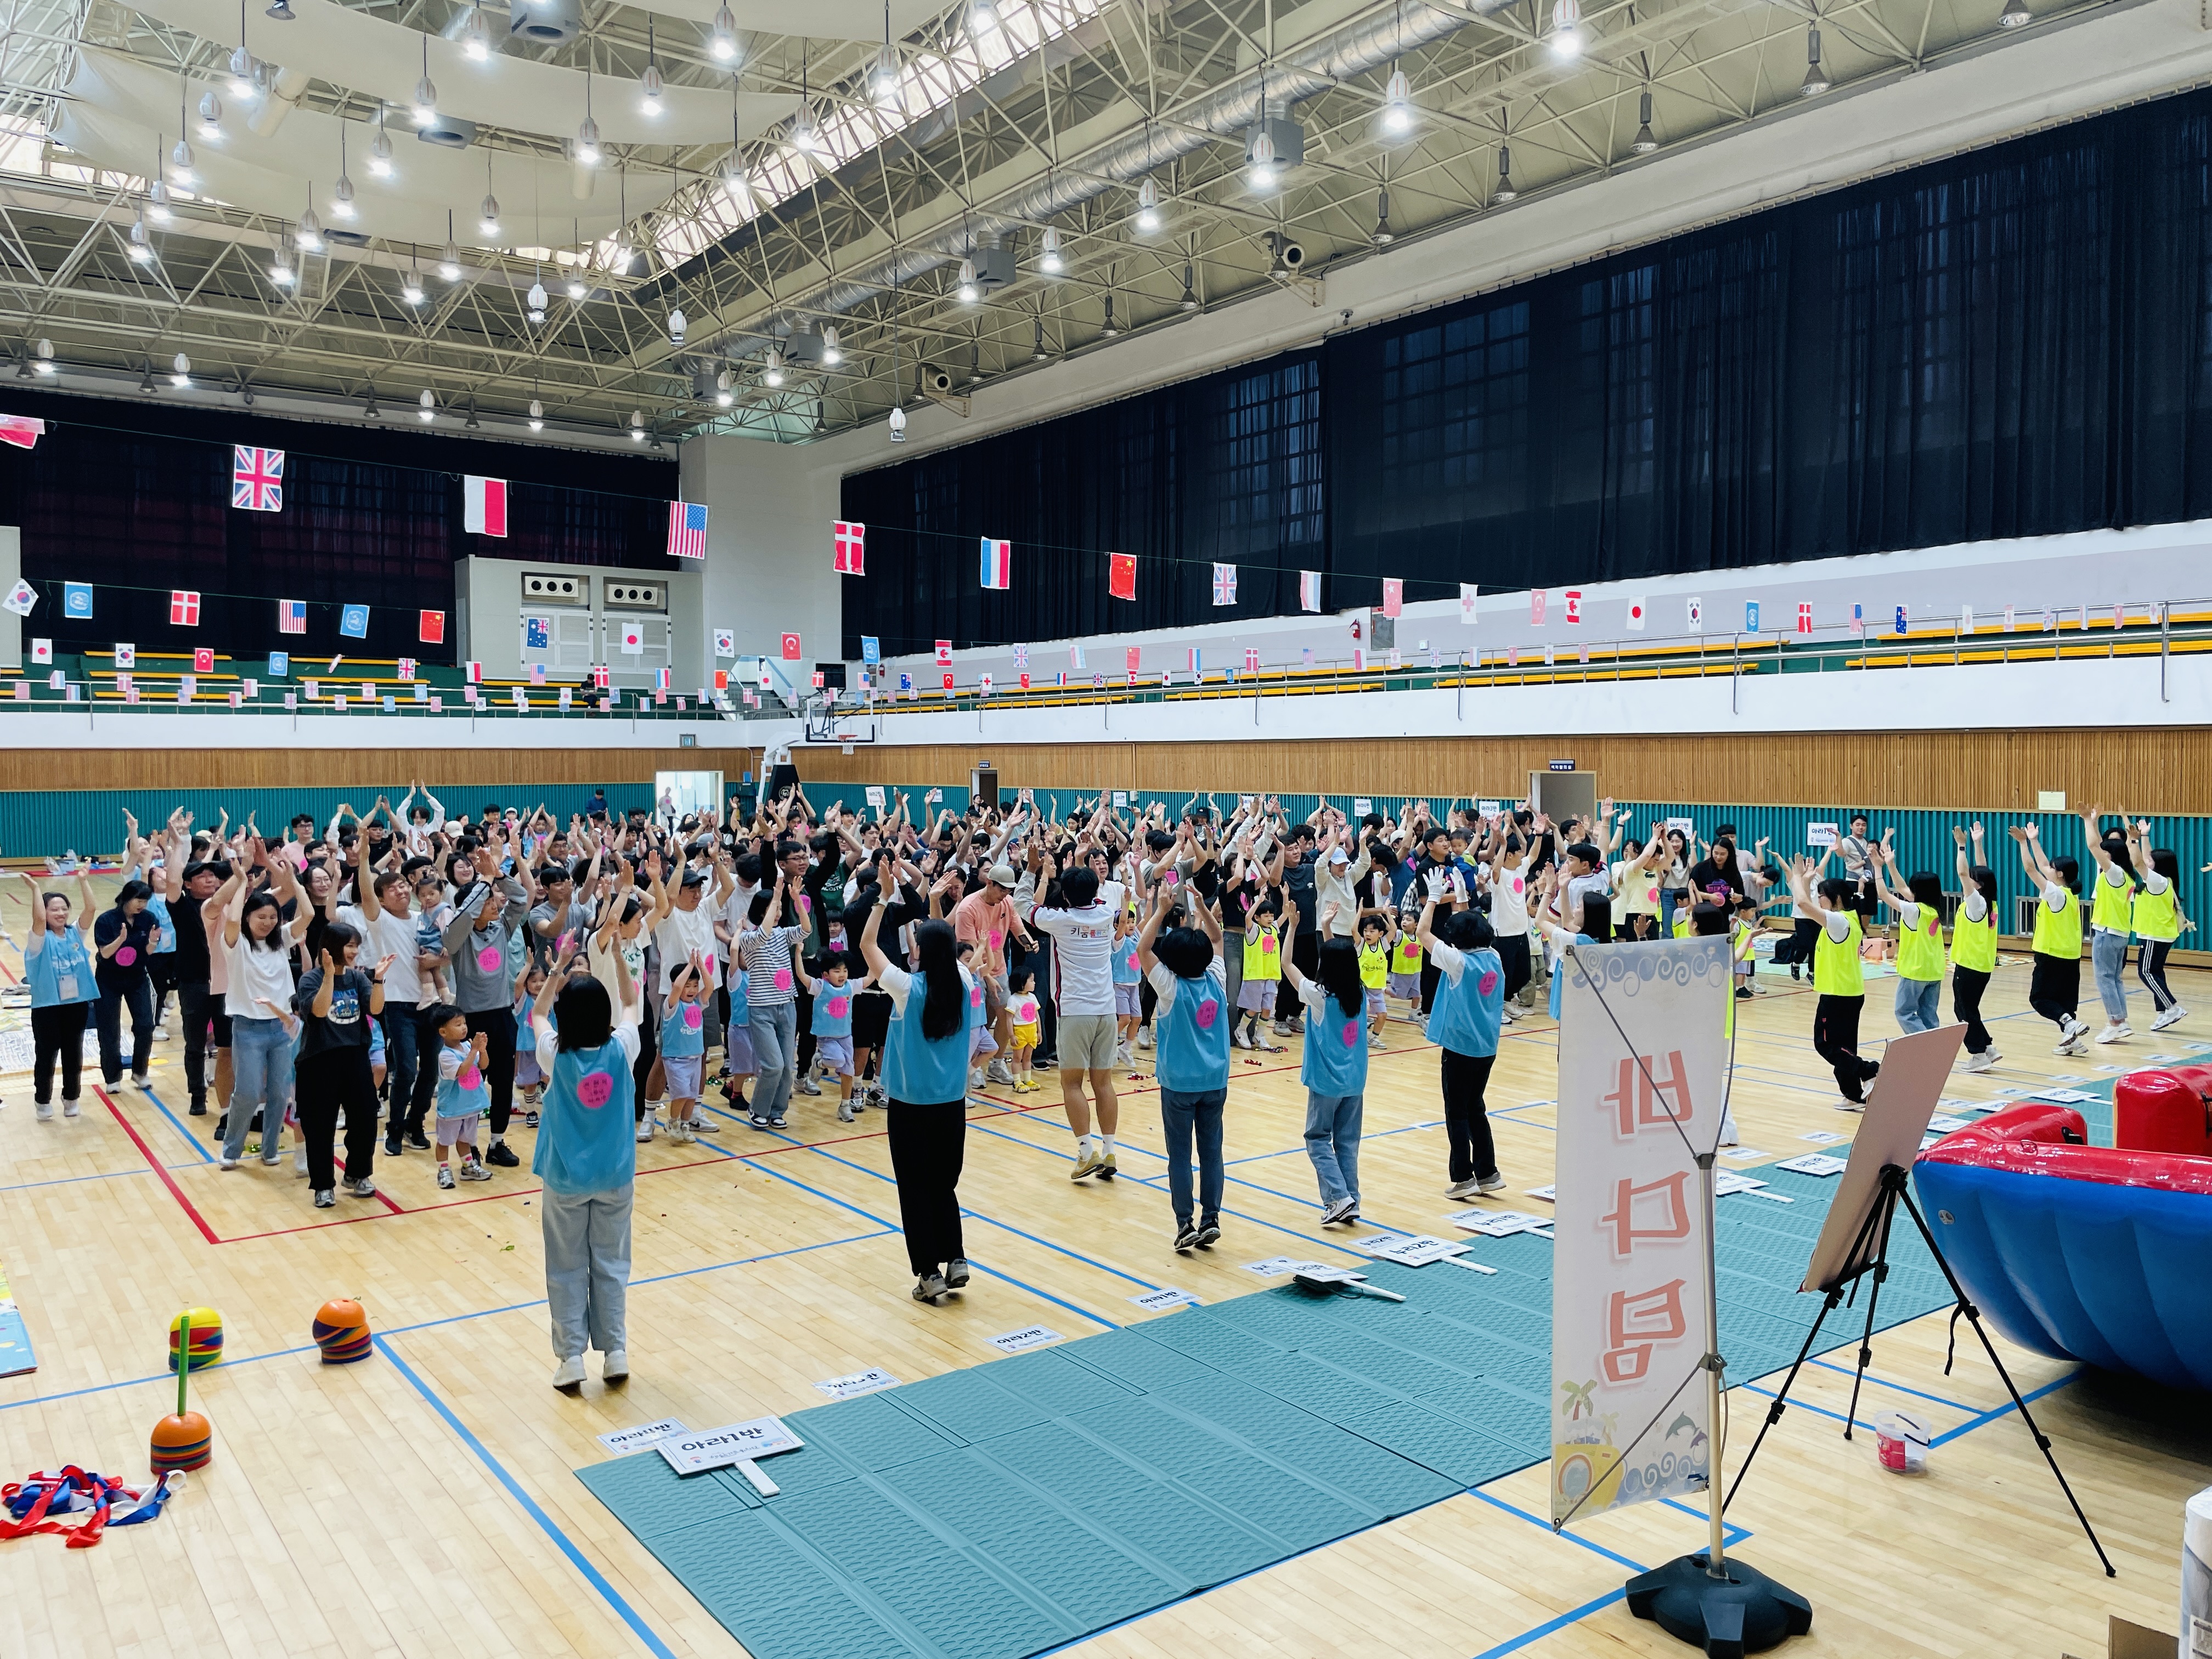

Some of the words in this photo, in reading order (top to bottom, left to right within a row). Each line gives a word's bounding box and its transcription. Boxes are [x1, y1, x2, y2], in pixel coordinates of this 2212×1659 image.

[1389, 1240, 1440, 1255] 누리2반
[1139, 1291, 1181, 1304] 아라1반
[997, 1329, 1044, 1344] 아라2반
[681, 1427, 765, 1451] 아라1반
